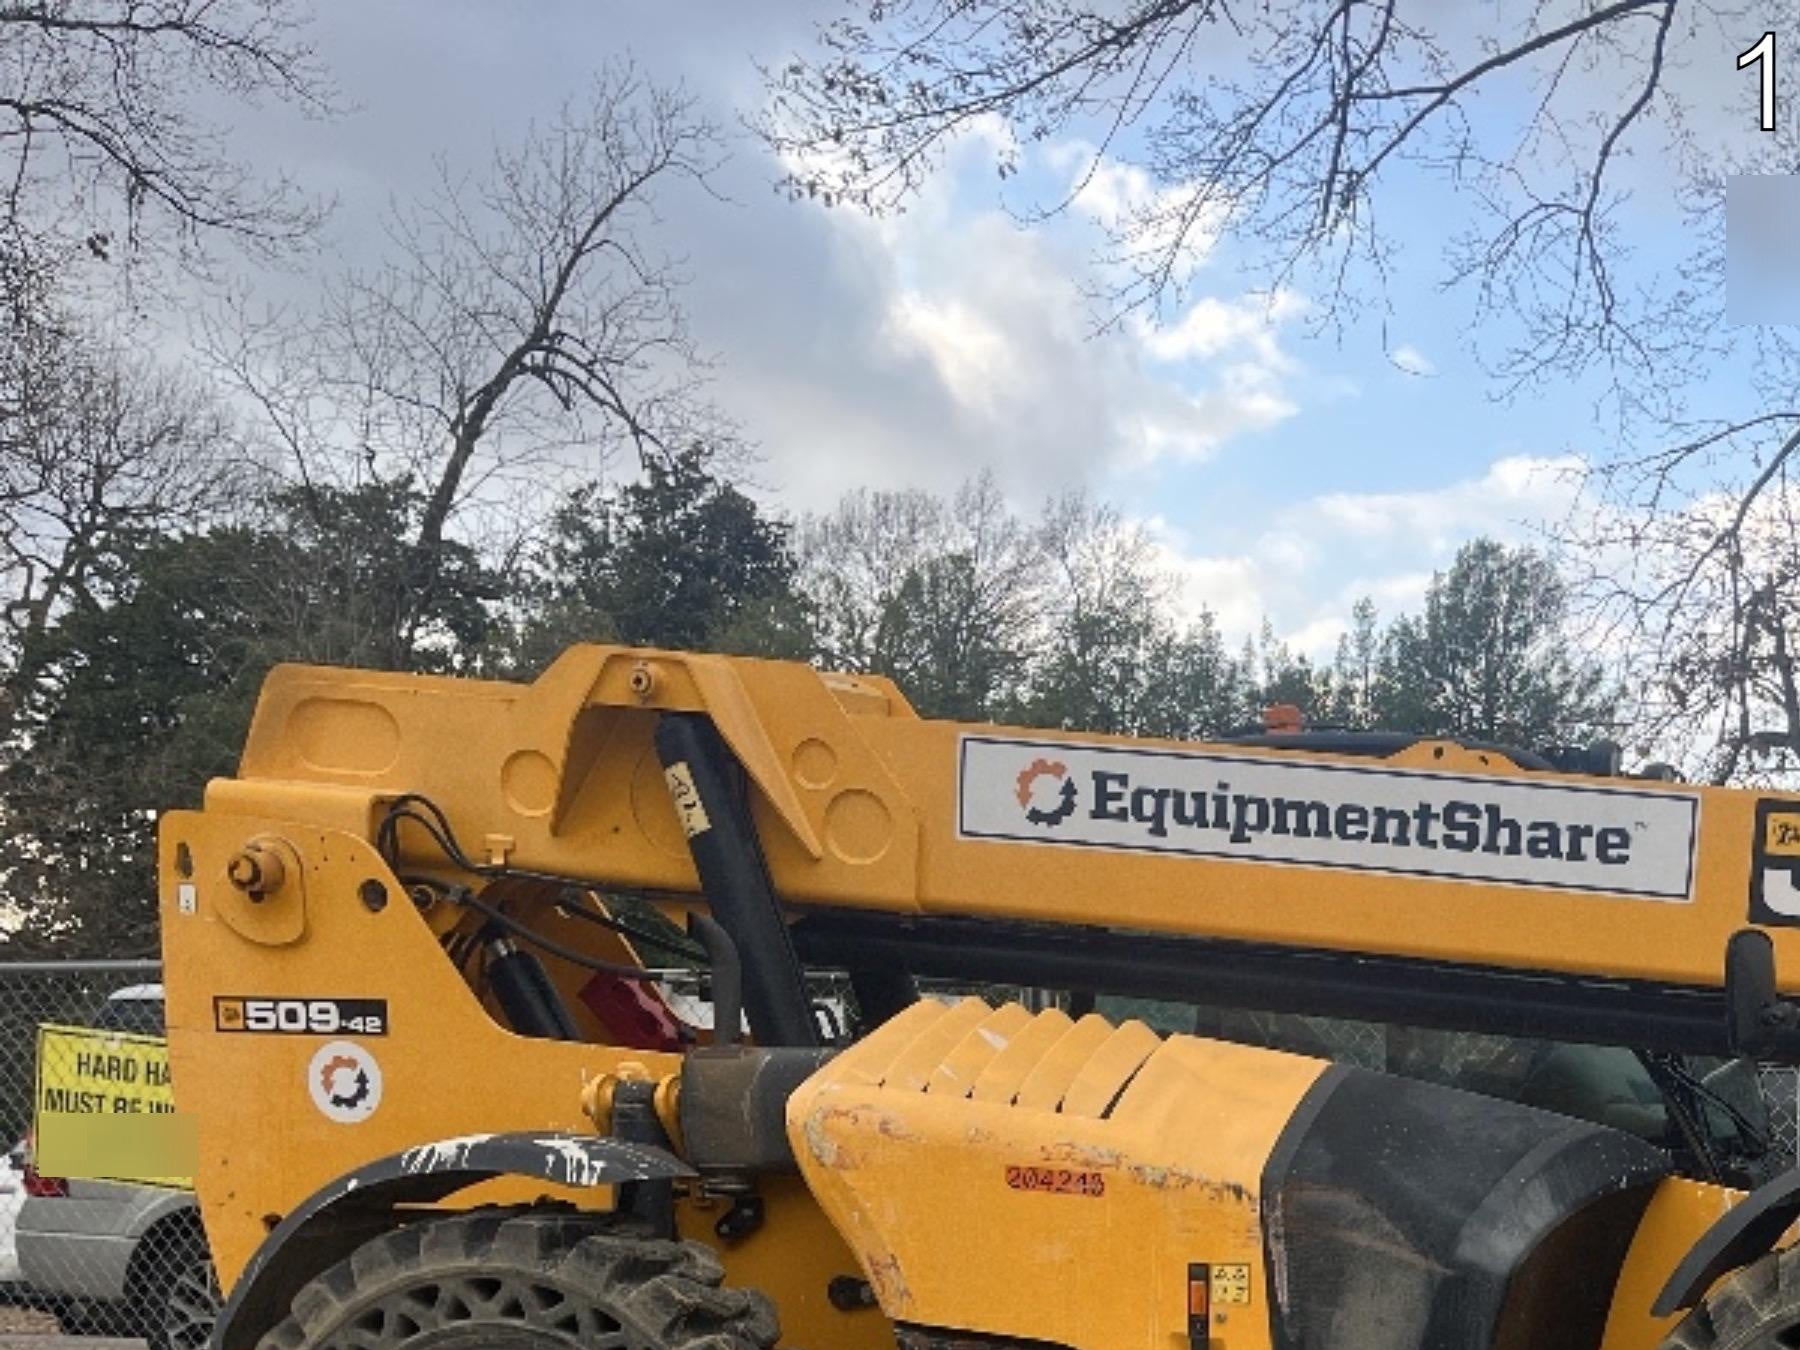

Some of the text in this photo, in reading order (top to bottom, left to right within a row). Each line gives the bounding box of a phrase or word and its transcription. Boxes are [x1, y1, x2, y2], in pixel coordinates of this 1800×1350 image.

[1089, 770, 1630, 866] EquipmentShare
[76, 1052, 136, 1084] HARD
[44, 1088, 106, 1114] MUST
